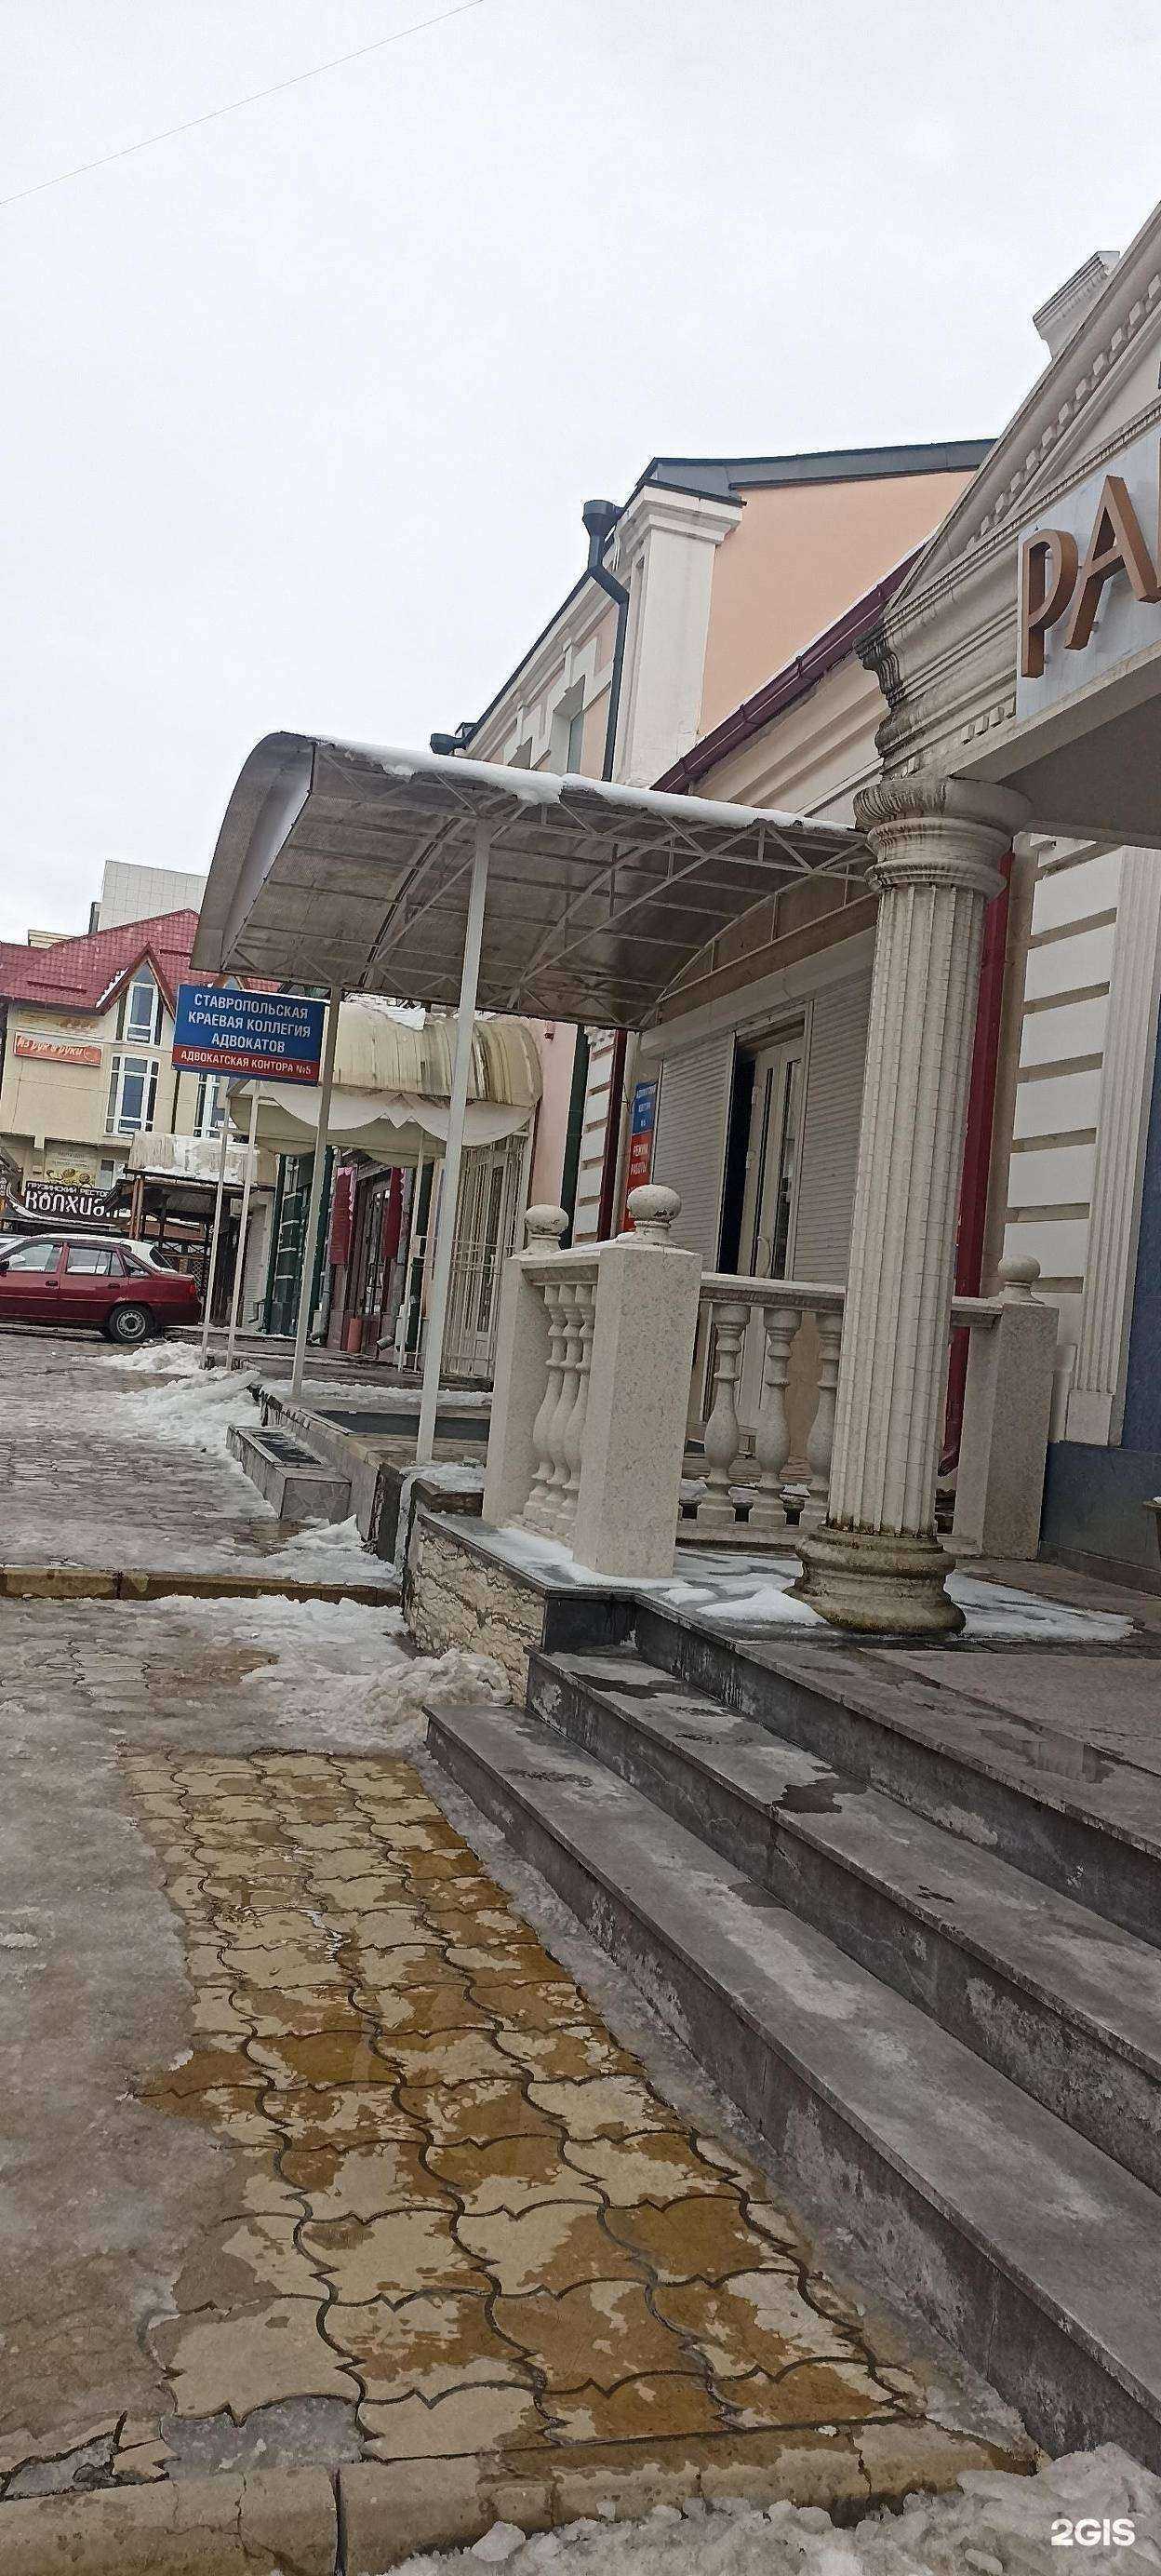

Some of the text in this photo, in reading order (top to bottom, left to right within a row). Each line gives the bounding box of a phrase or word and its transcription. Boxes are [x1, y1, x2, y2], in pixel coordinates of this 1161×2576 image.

[1021, 437, 1161, 678] РА
[194, 993, 309, 1019] СТАВРОПОЛЬСКАЯ
[188, 1011, 311, 1039] КРАЕВАЯ КОЛЛЕГИЯ
[211, 1032, 286, 1053] АДВОКАТОВ
[180, 1050, 312, 1075] АДВОКАТСКАЯ КОНТОРА №5
[27, 1182, 77, 1193] ГРУЗИНСКИЙ
